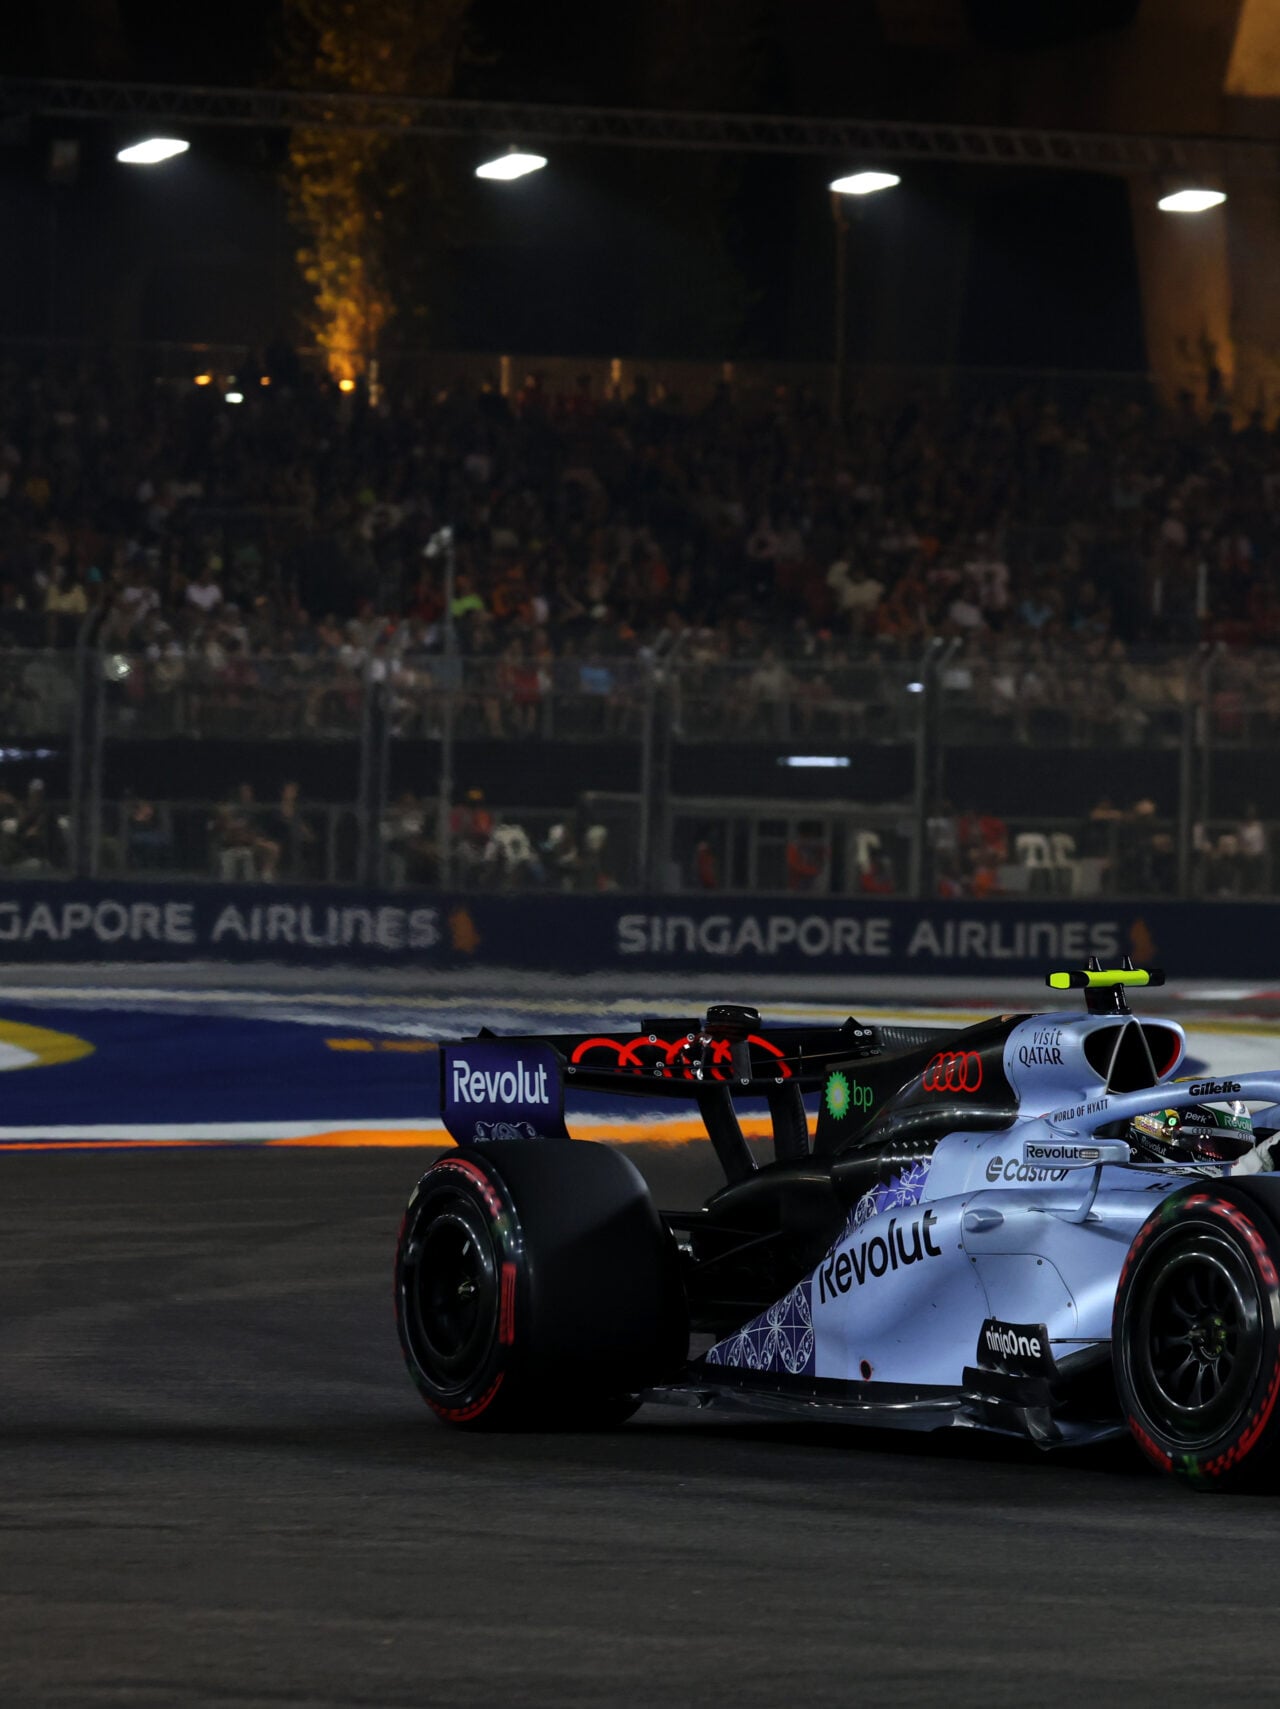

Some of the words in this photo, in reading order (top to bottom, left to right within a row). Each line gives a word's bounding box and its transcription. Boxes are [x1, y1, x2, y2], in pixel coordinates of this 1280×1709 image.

[211, 904, 440, 948] AIRLINES
[618, 914, 891, 956] SINGAPORE
[907, 919, 1118, 958] AIRLINES
[1033, 1028, 1062, 1046] visit
[1018, 1046, 1064, 1067] QATAR
[453, 1060, 549, 1104] Revolut
[852, 1080, 873, 1112] bp
[1188, 1081, 1241, 1096] Gillette
[1053, 1108, 1075, 1123] WORLD
[1076, 1104, 1086, 1117] OF
[1087, 1099, 1108, 1114] HYATT
[1026, 1145, 1079, 1159] Revolut
[819, 1209, 941, 1303] Revolut
[985, 1325, 1042, 1360] ninjaOne
